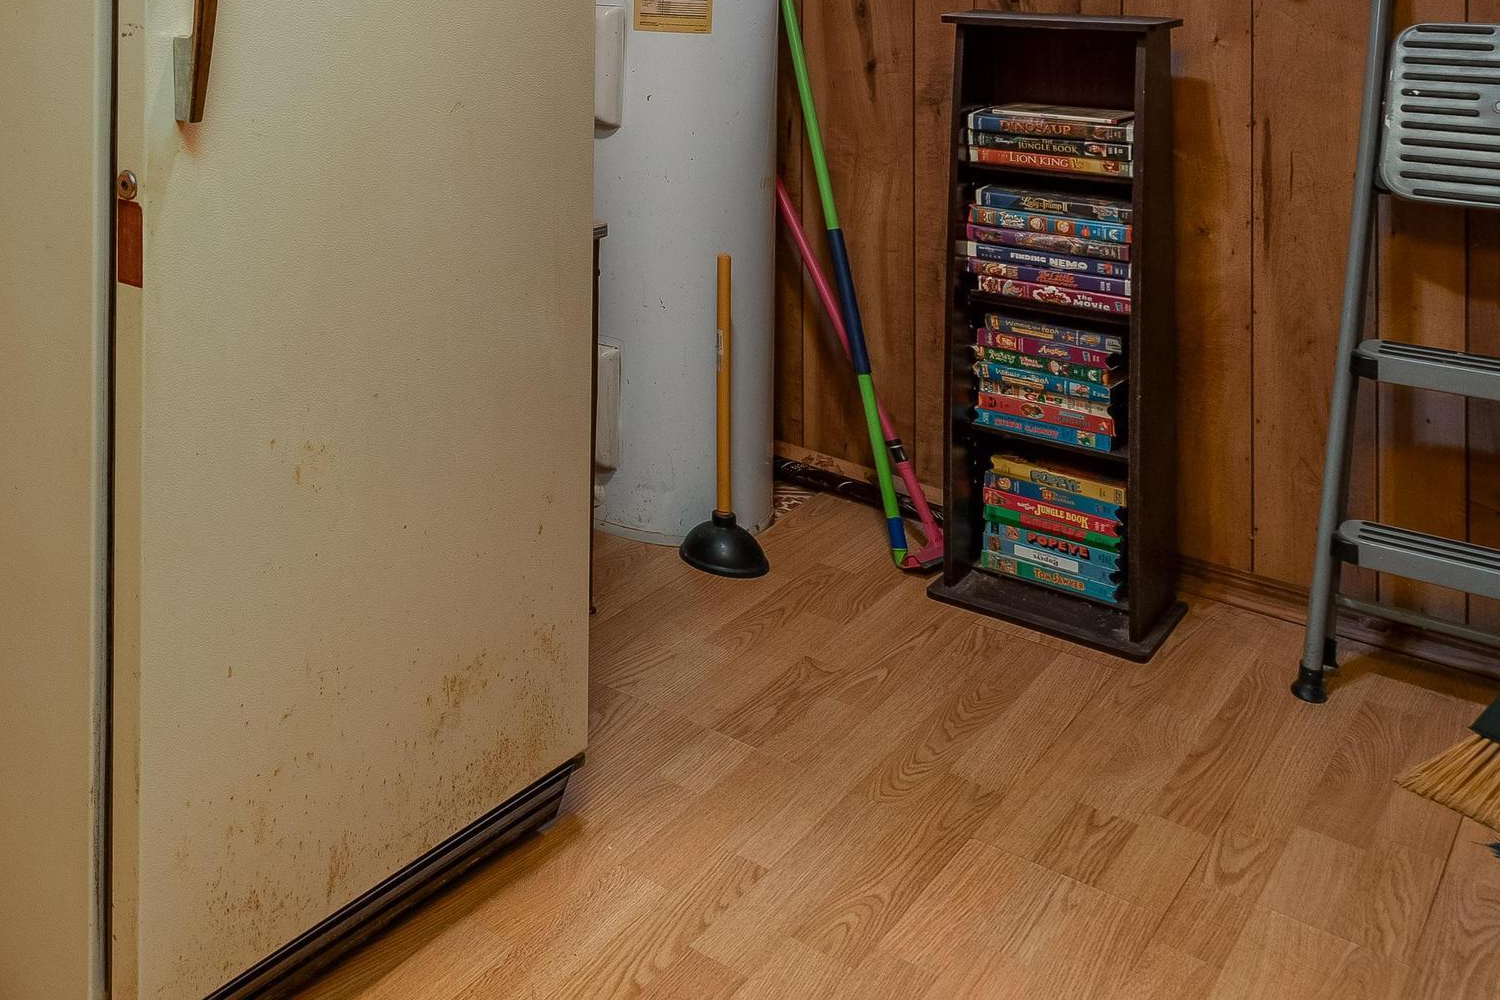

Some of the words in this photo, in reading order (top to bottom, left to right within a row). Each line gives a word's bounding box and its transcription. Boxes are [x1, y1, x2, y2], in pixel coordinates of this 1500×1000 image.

[1018, 141, 1051, 152] JUNGLE
[1052, 143, 1079, 155] BOOK
[1009, 151, 1039, 163] LION
[1039, 156, 1069, 169] KING
[1010, 252, 1047, 264] FINDING
[1049, 257, 1088, 271] NEMO
[1034, 504, 1065, 520] JUNGLE
[1065, 510, 1089, 529] BOOK
[1027, 532, 1090, 559] POPEYE
